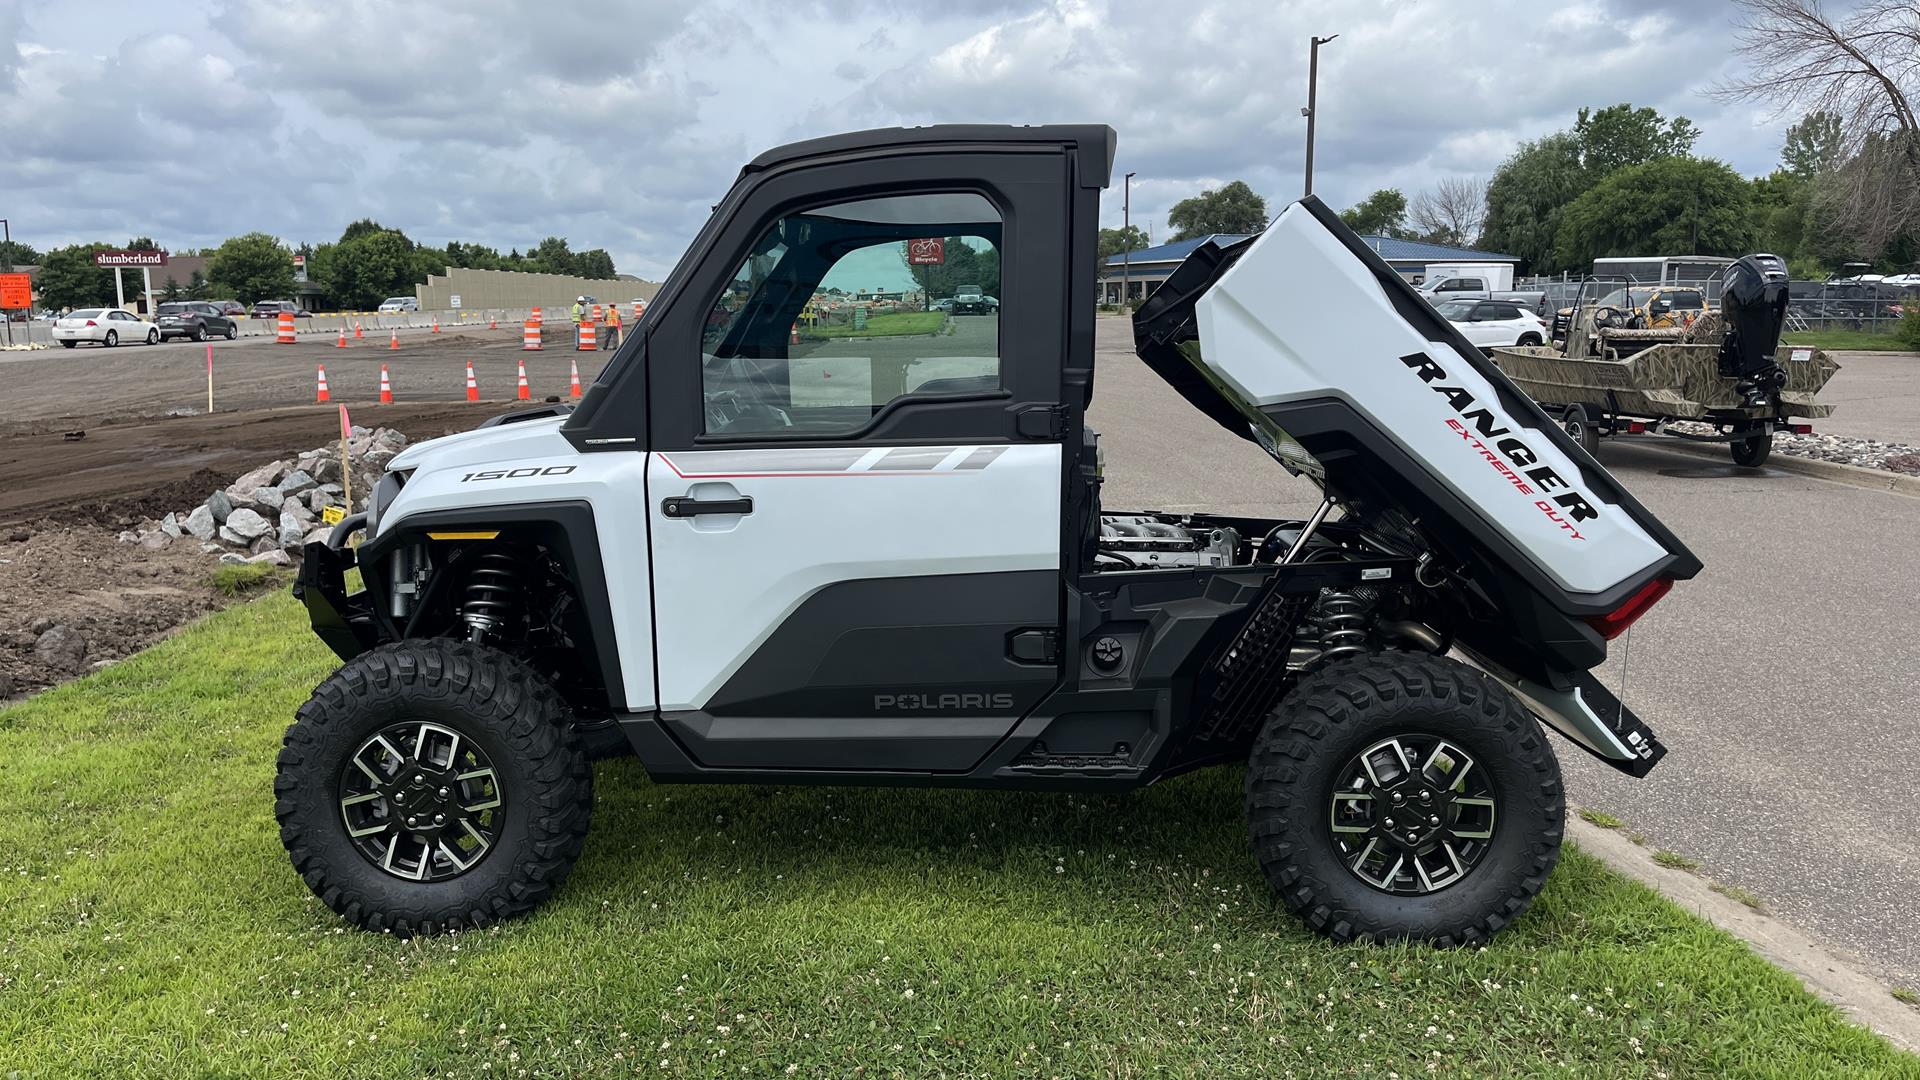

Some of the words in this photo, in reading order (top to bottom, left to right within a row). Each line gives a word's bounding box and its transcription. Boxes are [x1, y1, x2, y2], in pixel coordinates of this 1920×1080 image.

[97, 253, 161, 264] slumberland
[1399, 352, 1599, 523] RANGER
[461, 465, 578, 483] 1500
[1444, 418, 1535, 496] EXTREME
[1534, 501, 1586, 541] DUTY
[874, 693, 1014, 710] POLARIS
